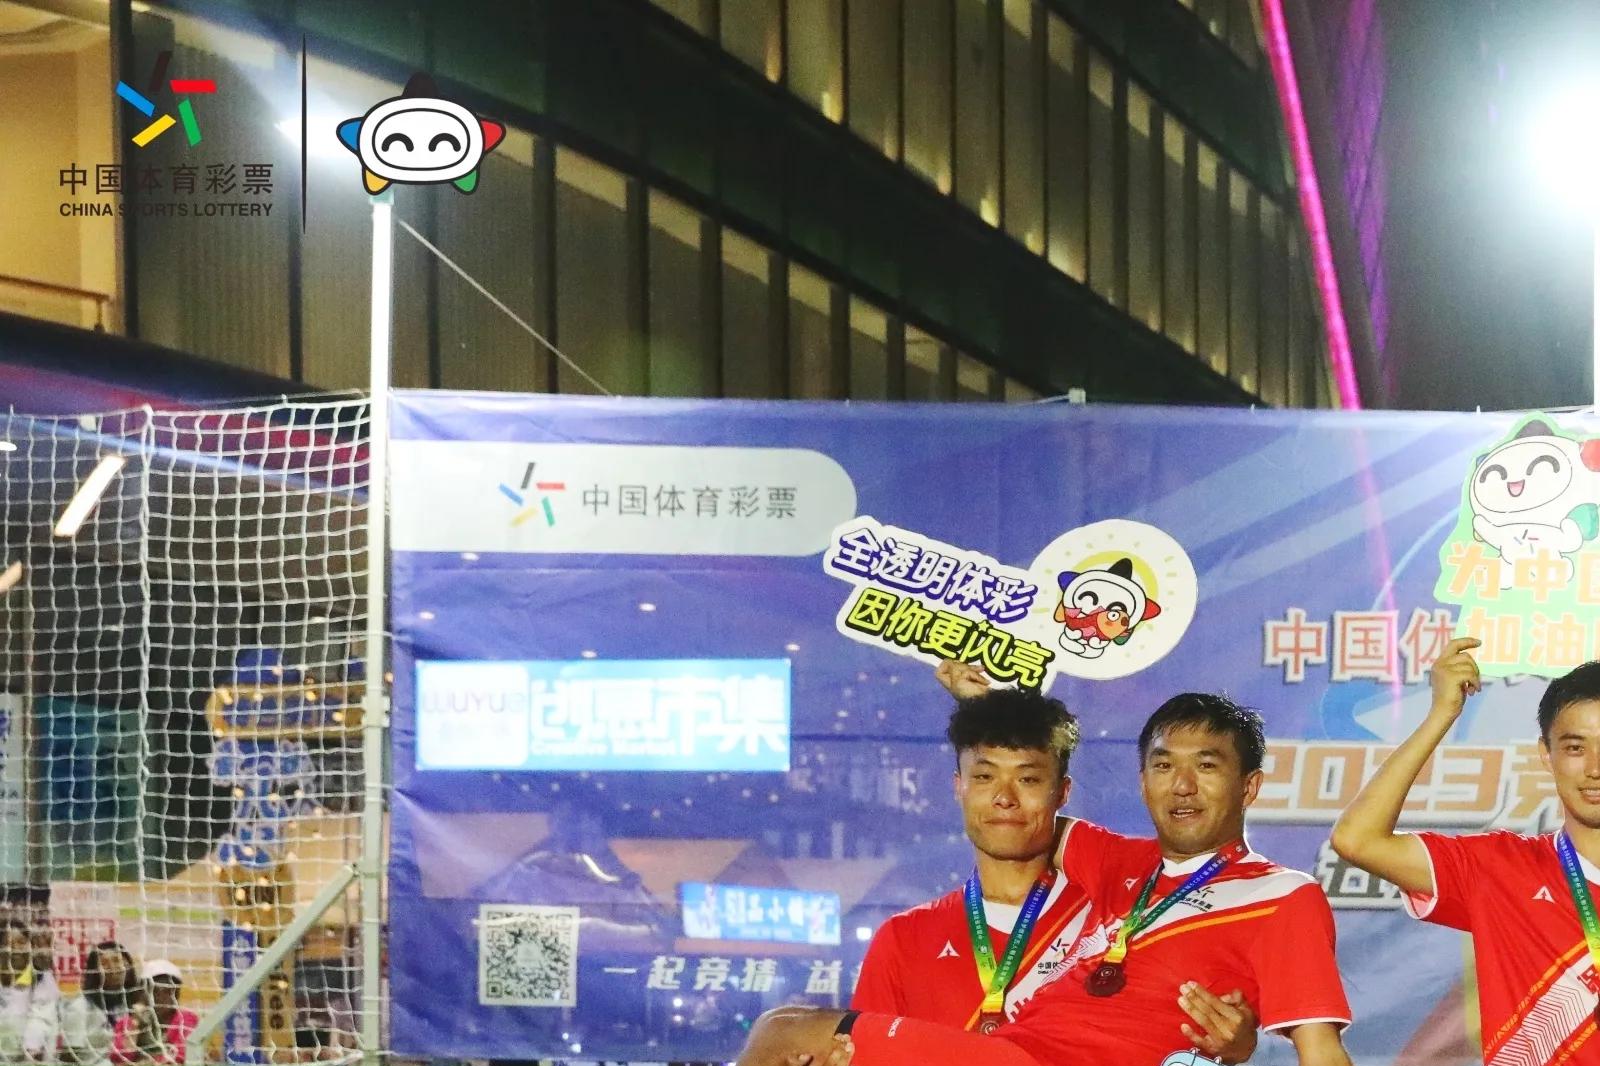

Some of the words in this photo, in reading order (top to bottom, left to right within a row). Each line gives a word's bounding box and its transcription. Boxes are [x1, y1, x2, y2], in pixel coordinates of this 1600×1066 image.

[583, 484, 798, 520] 中国体育彩票
[831, 528, 1038, 624] 全透明体彩
[845, 587, 1055, 688] 因你更闪亮
[603, 955, 778, 993] 一起竞猜
